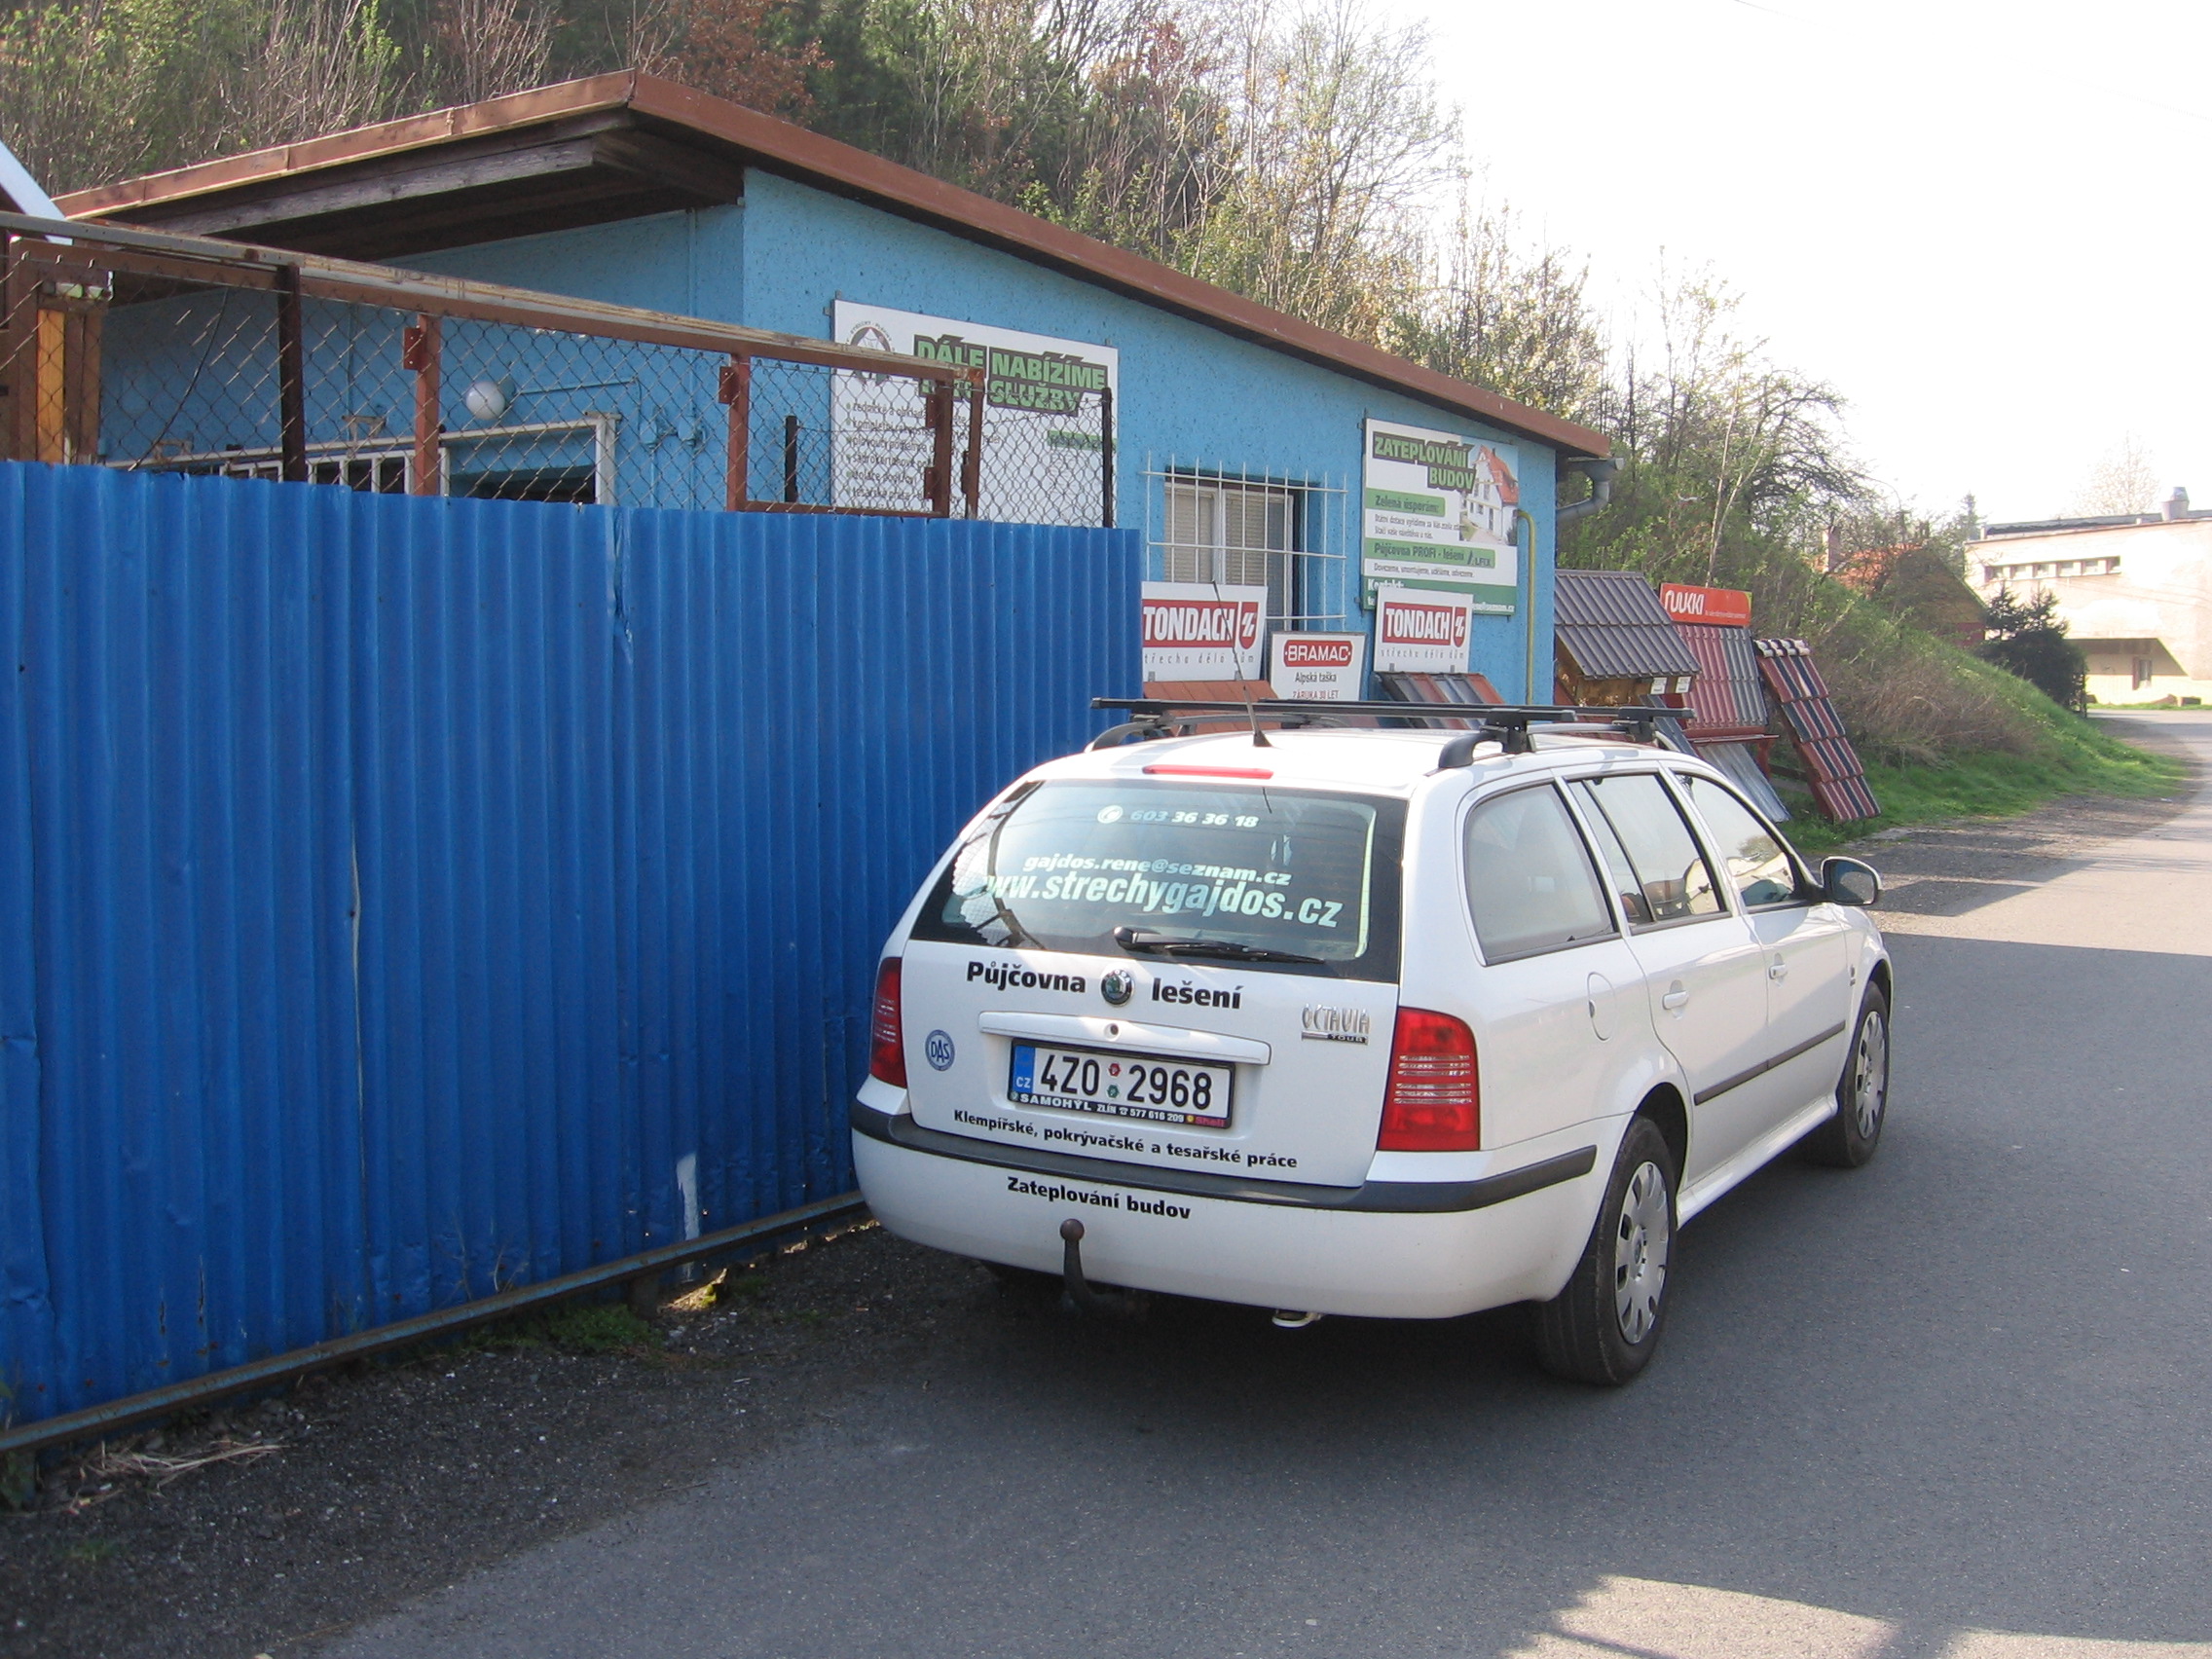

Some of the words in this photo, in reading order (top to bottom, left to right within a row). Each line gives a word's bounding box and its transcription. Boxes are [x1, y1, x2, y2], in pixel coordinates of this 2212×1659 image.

[916, 338, 985, 369] DÁLE
[991, 351, 1107, 390] NABÍZÍME
[989, 380, 1081, 412] SLUŽBY
[1374, 435, 1467, 467] ZATEPLOVÁNÍ
[1429, 467, 1474, 490] BUDOV
[1142, 606, 1235, 642] TONDACH
[1385, 608, 1451, 640] TONDACH
[1287, 644, 1349, 662] BRAMAC
[1129, 809, 1167, 822] 603
[1171, 811, 1198, 824] 36
[1201, 813, 1229, 826] 36
[1234, 815, 1259, 828] 18
[1022, 853, 1292, 886] gajdos.rene@seznam.cz
[987, 871, 1344, 928] ww.strechygajdos.cz
[966, 960, 1087, 994] Půjčovna
[1151, 977, 1245, 1010] lešení
[1302, 1003, 1370, 1034] OCTAVIA
[931, 1040, 950, 1063] DAS
[1015, 1077, 1031, 1089] CZ
[1126, 1064, 1212, 1110] 2968
[1019, 1093, 1092, 1112] SAMOHÝL
[1129, 1109, 1147, 1119] 577
[954, 1109, 1038, 1138] Klempířské,
[1044, 1127, 1145, 1153] pokrývačské
[1151, 1143, 1161, 1155] a
[1166, 1142, 1241, 1163] tesařské
[1247, 1152, 1298, 1168] práce
[1007, 1175, 1120, 1209] Zateplování
[1126, 1195, 1192, 1219] budov
